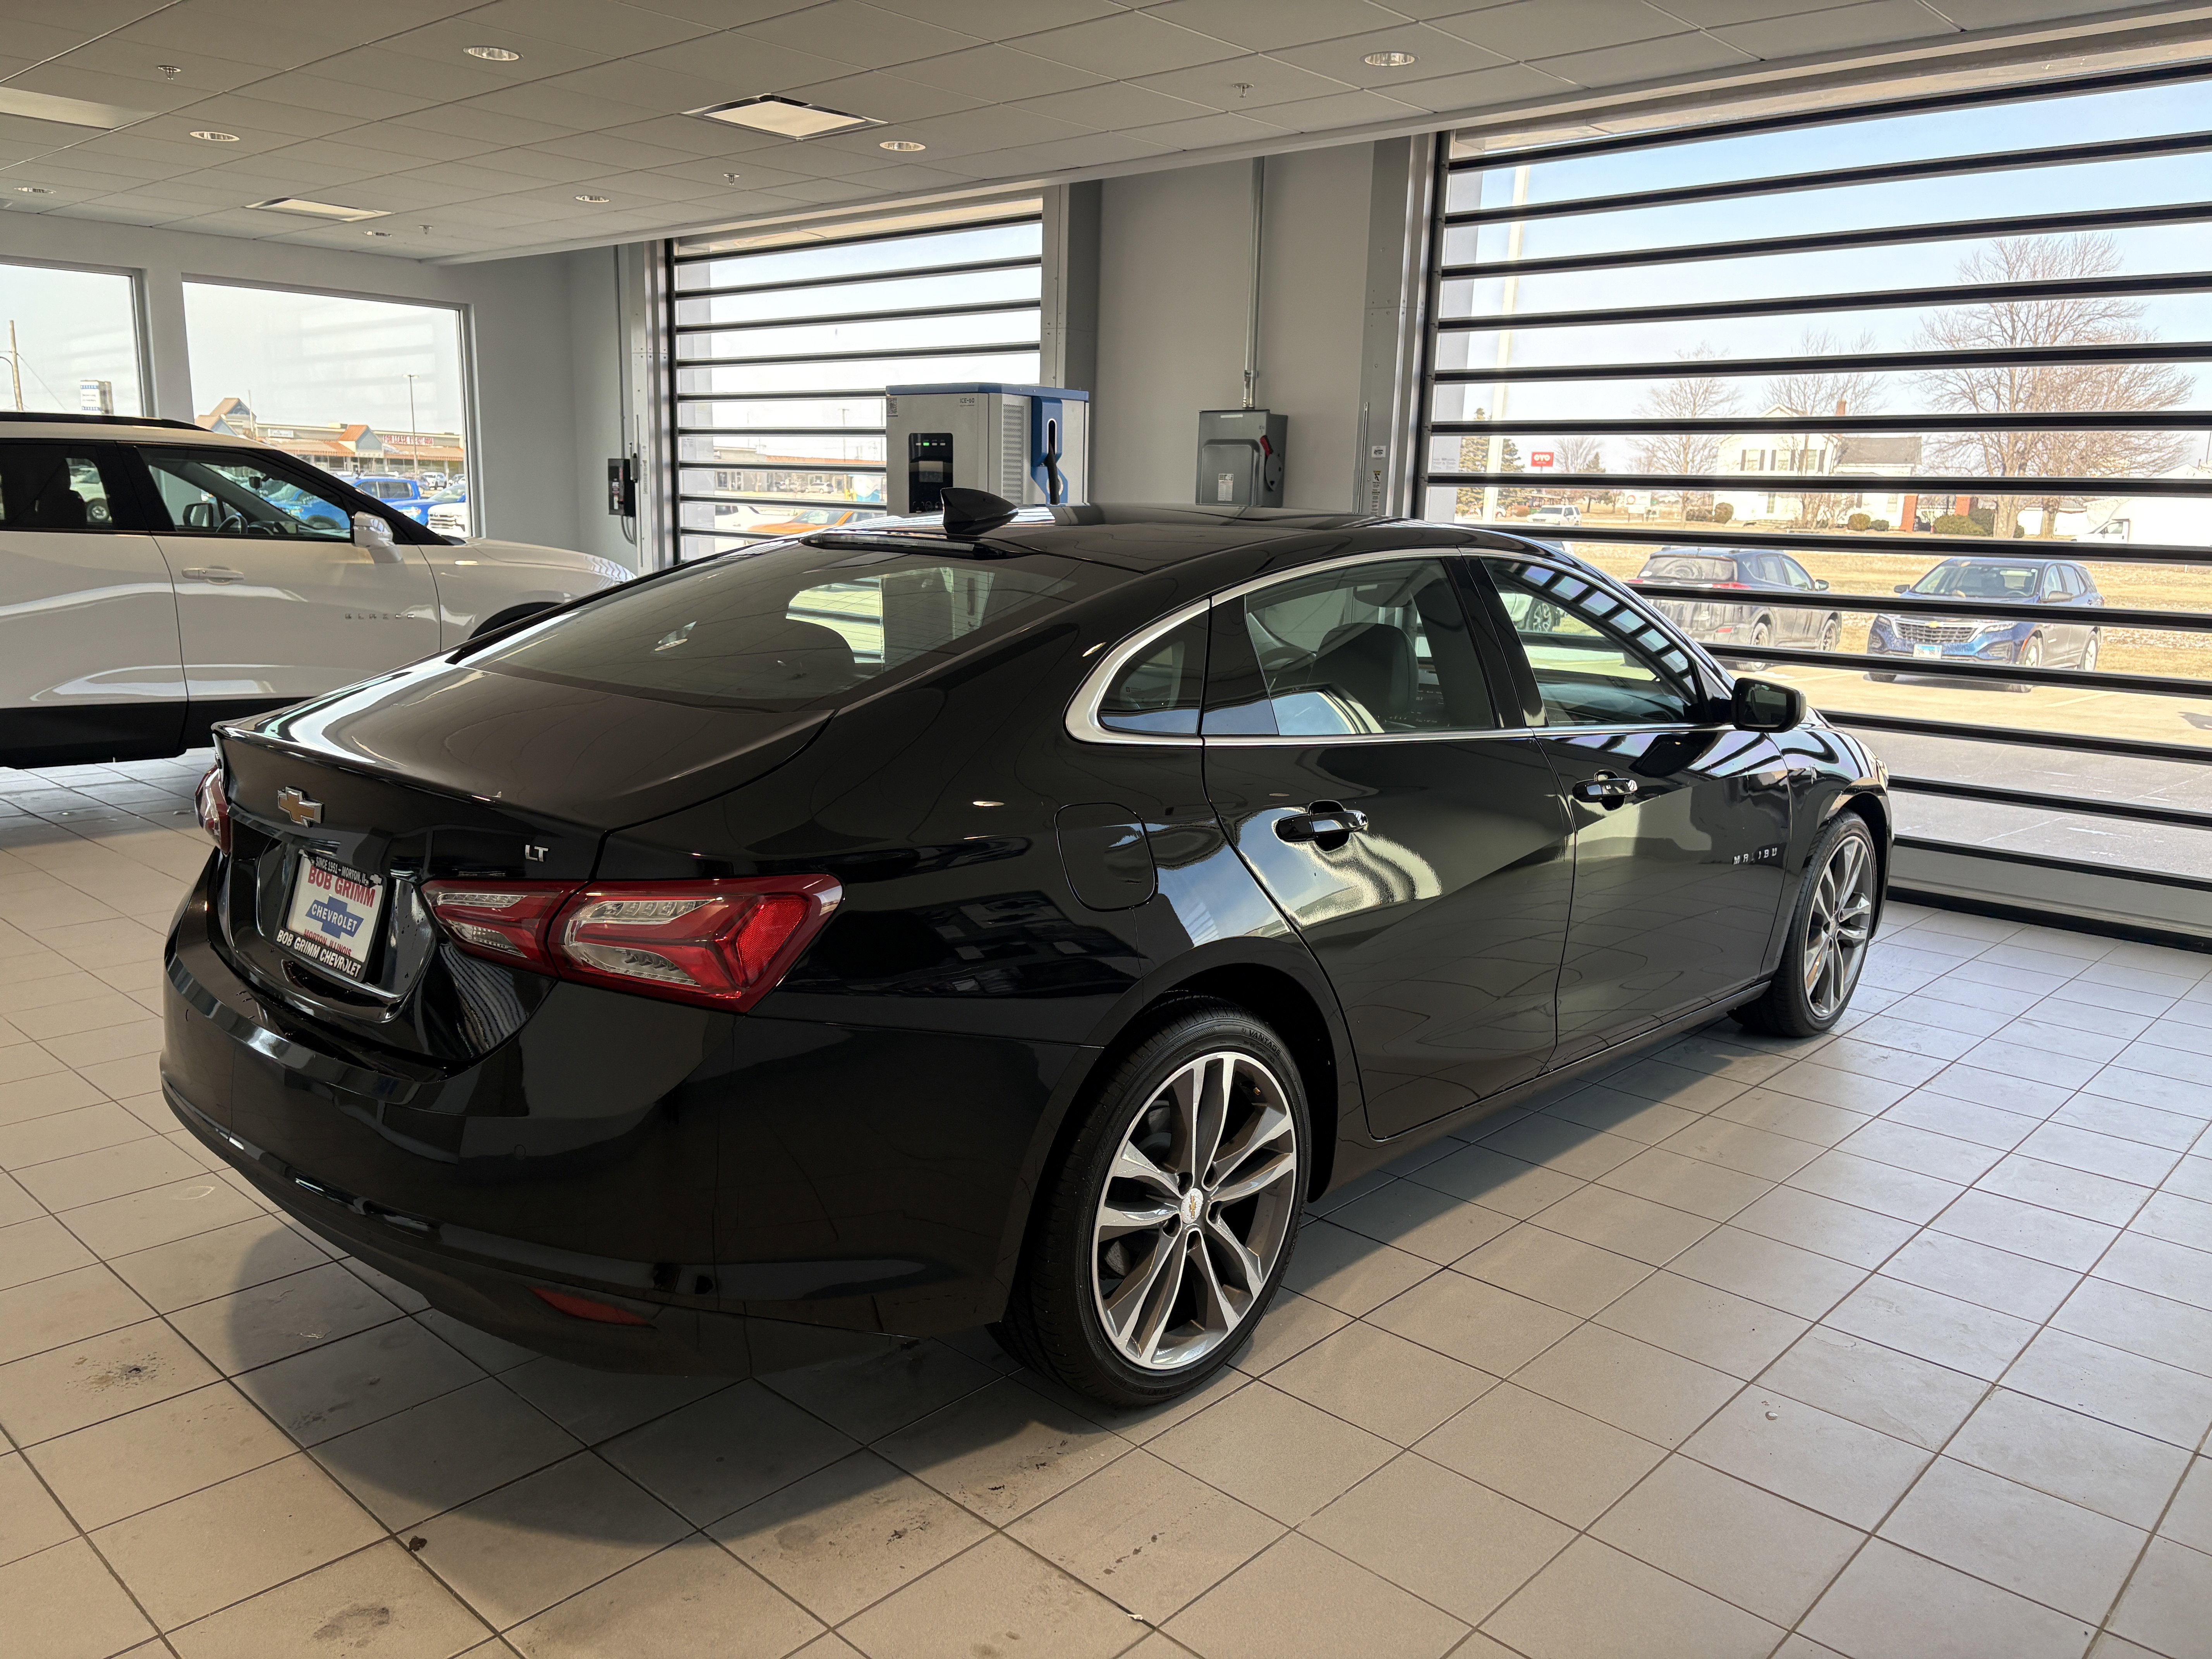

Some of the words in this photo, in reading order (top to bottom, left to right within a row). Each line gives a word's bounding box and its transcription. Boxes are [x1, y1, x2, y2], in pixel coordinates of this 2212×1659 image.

[315, 856, 327, 870] SINCE
[328, 861, 338, 874] 1951
[525, 845, 548, 862] LT
[1733, 847, 1777, 865] MALIBU
[308, 866, 333, 890] BOB
[335, 876, 376, 908] GRIMM
[311, 904, 357, 932] CHEVROLET
[276, 929, 294, 946] BOB
[294, 937, 321, 959] GRIMM
[319, 948, 361, 977] CHEVROLET
[1249, 1030, 1281, 1056] VANTAGE
